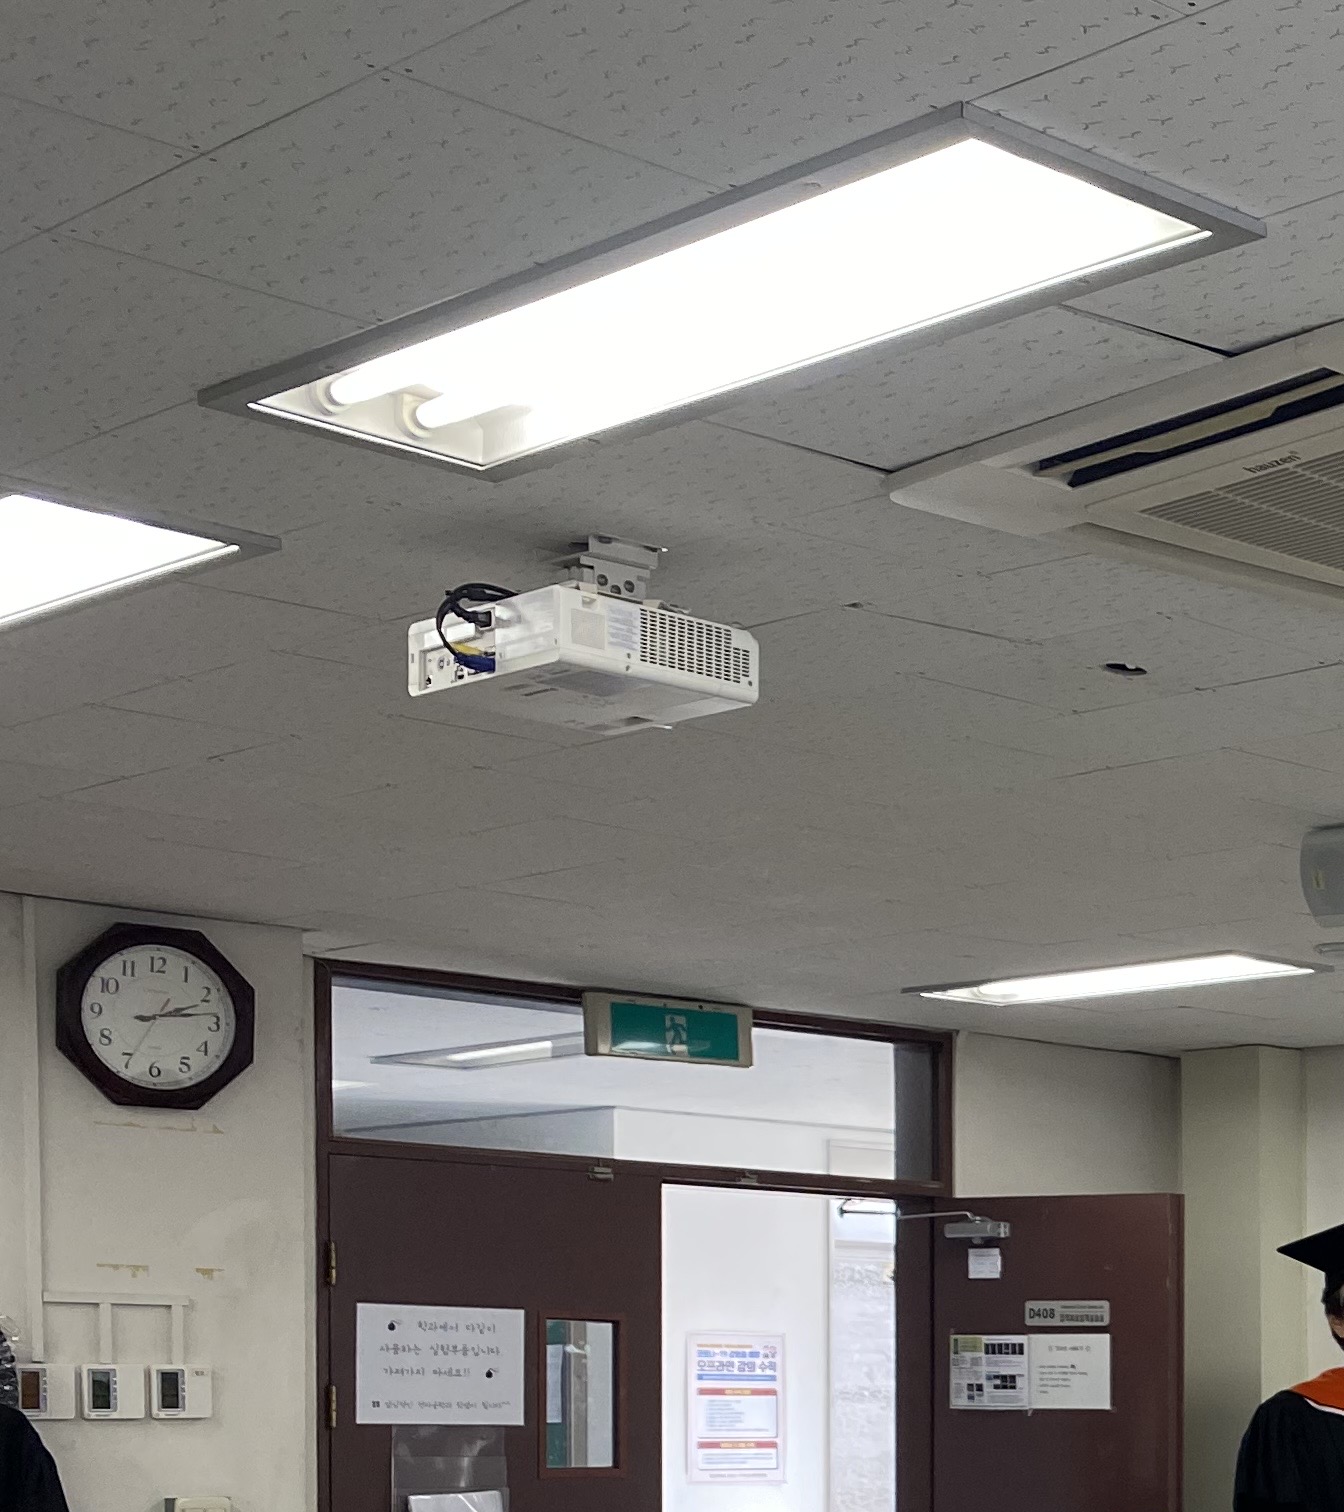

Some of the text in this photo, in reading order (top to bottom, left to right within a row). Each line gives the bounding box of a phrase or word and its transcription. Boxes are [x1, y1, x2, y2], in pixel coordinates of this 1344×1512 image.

[121, 959, 136, 978] 11
[149, 956, 167, 974] 12
[182, 966, 190, 984] 1
[100, 976, 119, 995] 10
[200, 986, 211, 1004] 2
[89, 1002, 103, 1020] 9
[207, 1014, 221, 1033] 3
[98, 1027, 113, 1046] 8
[195, 1040, 209, 1057] 4
[121, 1051, 134, 1070] 7
[148, 1060, 162, 1078] 6
[179, 1055, 192, 1074] 5
